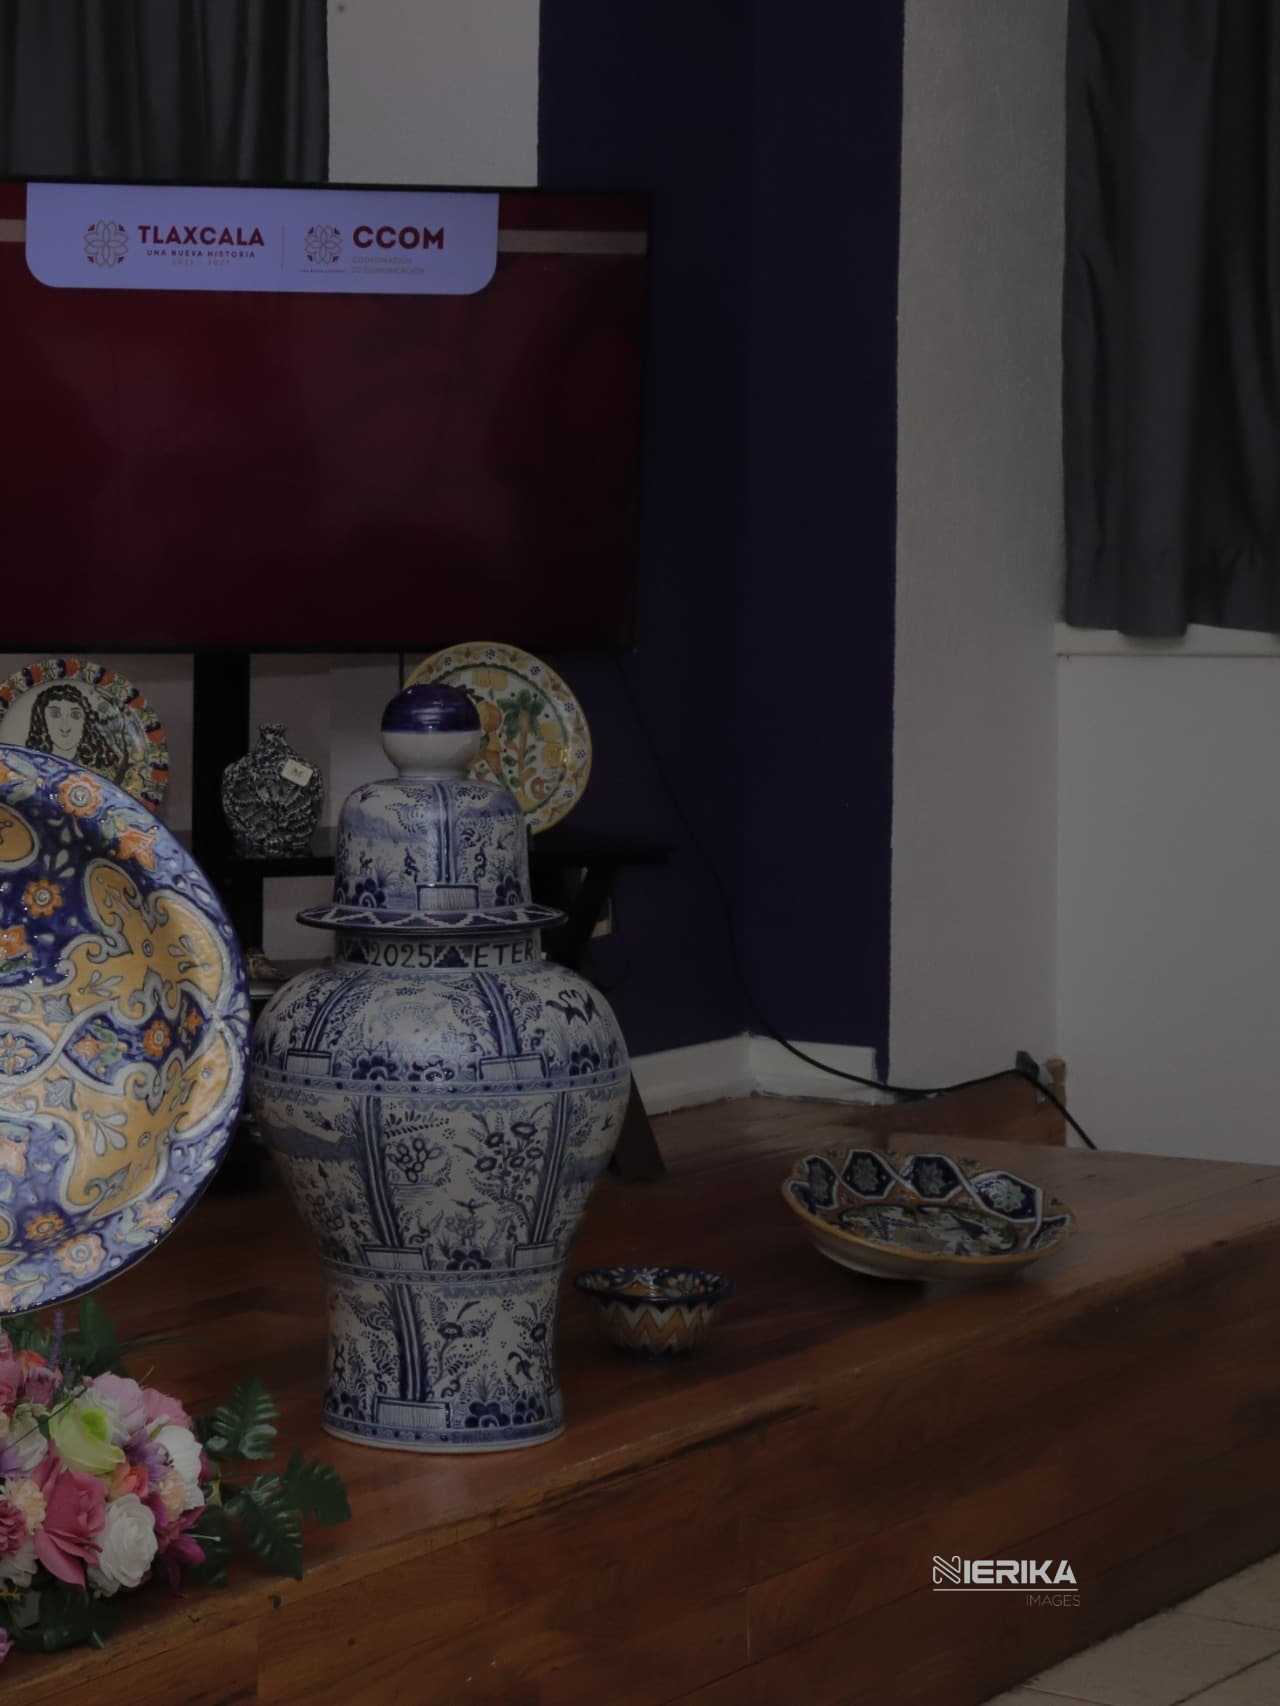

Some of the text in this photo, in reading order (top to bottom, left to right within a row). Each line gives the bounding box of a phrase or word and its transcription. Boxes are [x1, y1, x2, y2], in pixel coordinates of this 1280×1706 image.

[137, 225, 265, 247] TLAXCALA
[352, 225, 445, 250] CCOM
[147, 249, 167, 257] UNA
[207, 250, 256, 259] HISTORIA
[371, 943, 433, 968] 2025
